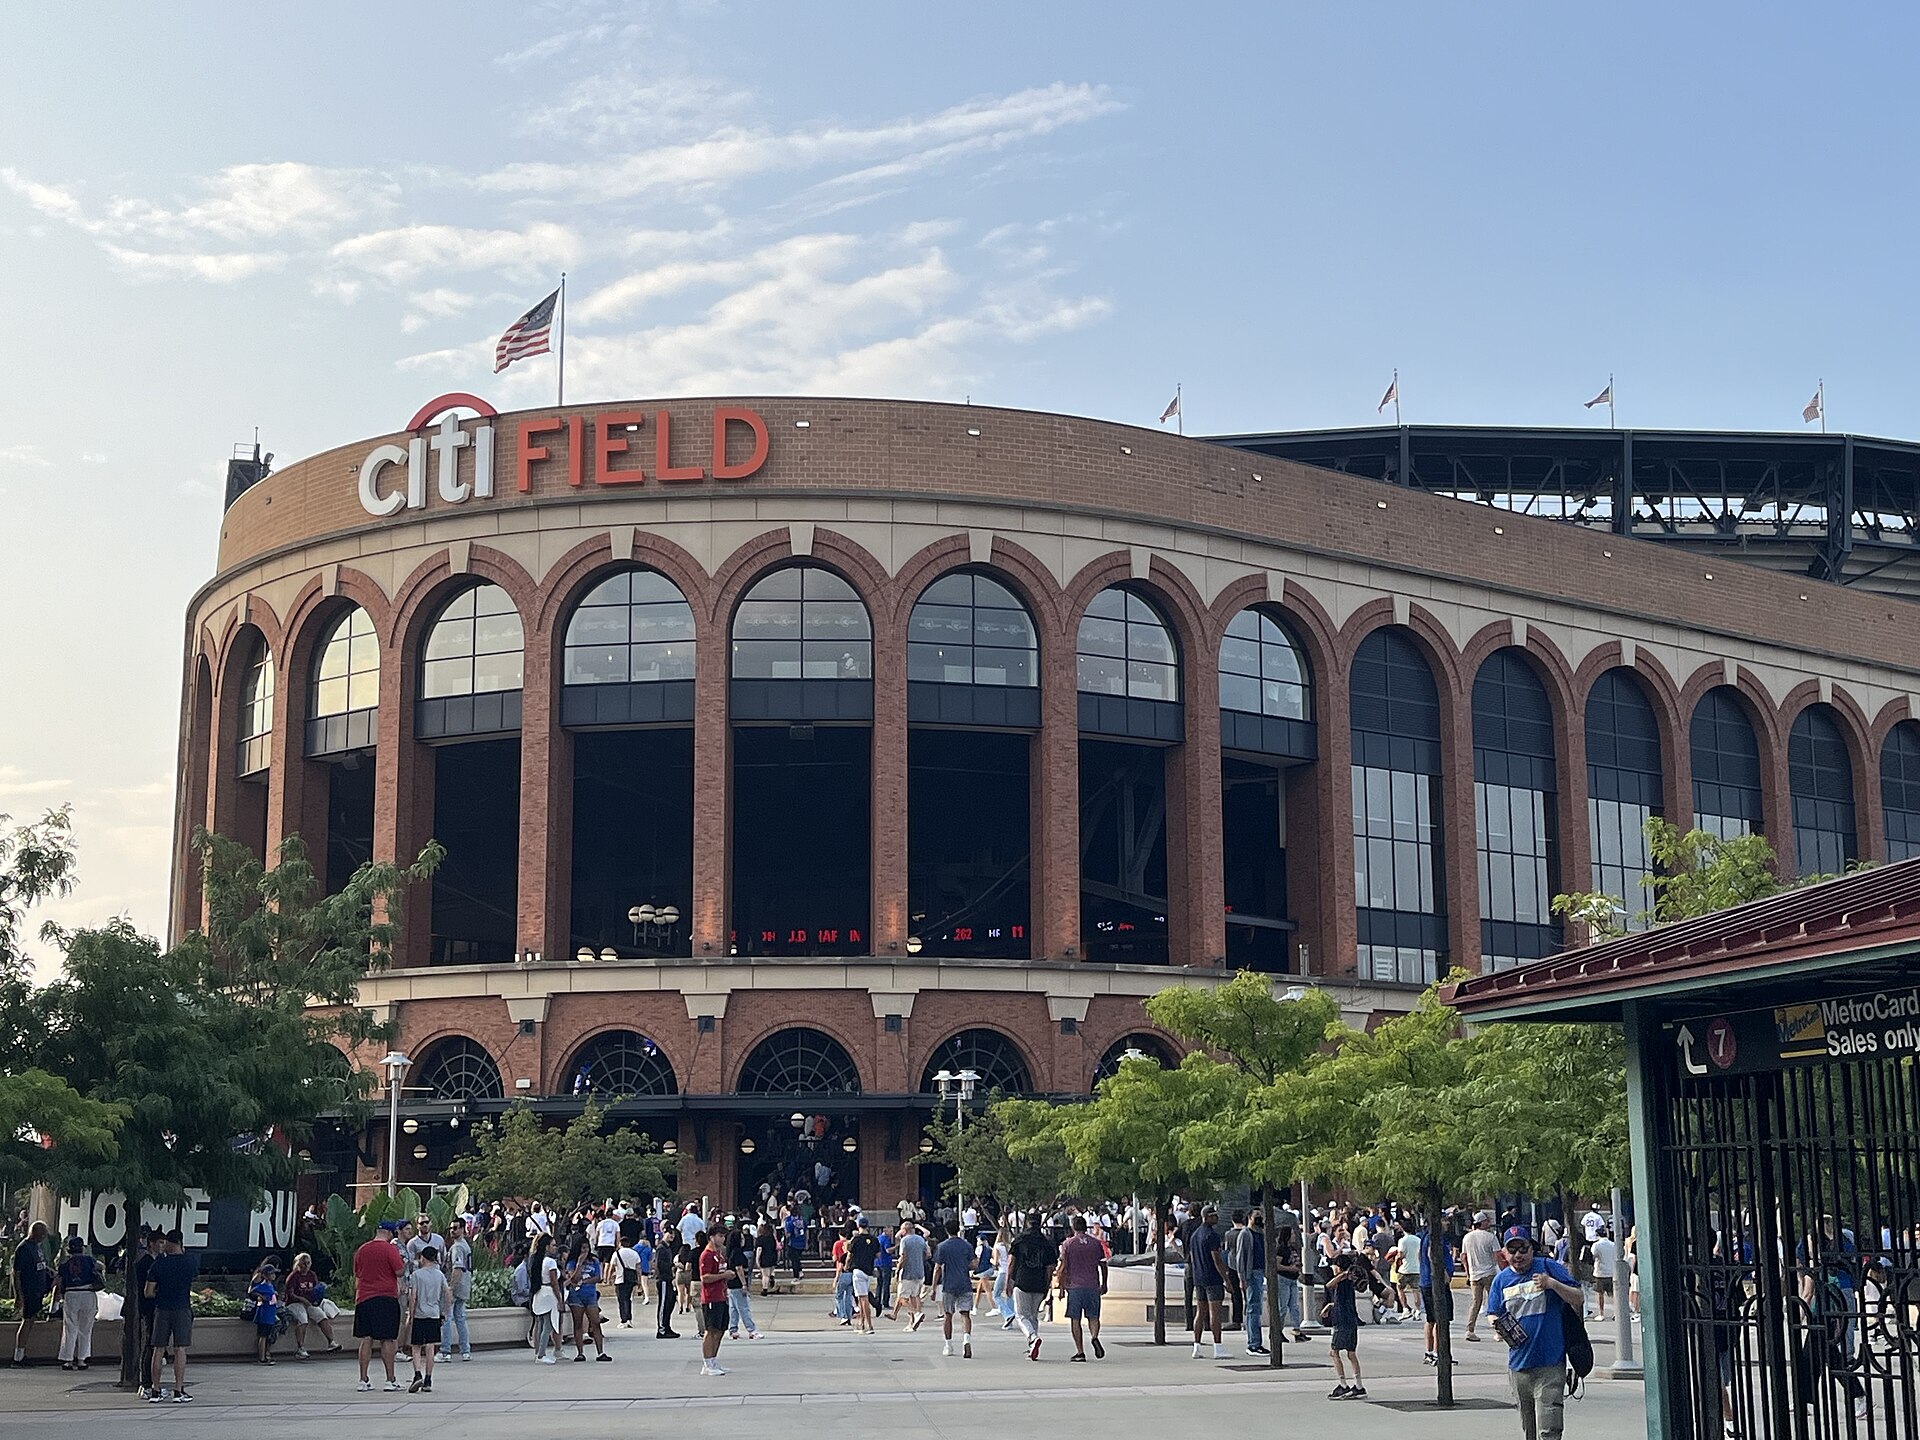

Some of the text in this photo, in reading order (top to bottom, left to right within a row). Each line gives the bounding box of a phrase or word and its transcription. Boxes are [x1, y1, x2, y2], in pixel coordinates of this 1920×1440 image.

[358, 408, 770, 516] citi FIELD
[1821, 989, 1920, 1026] MetroCard
[1714, 1028, 1726, 1057] 7
[1827, 1021, 1920, 1056] Sales only
[248, 1189, 297, 1248] RU
